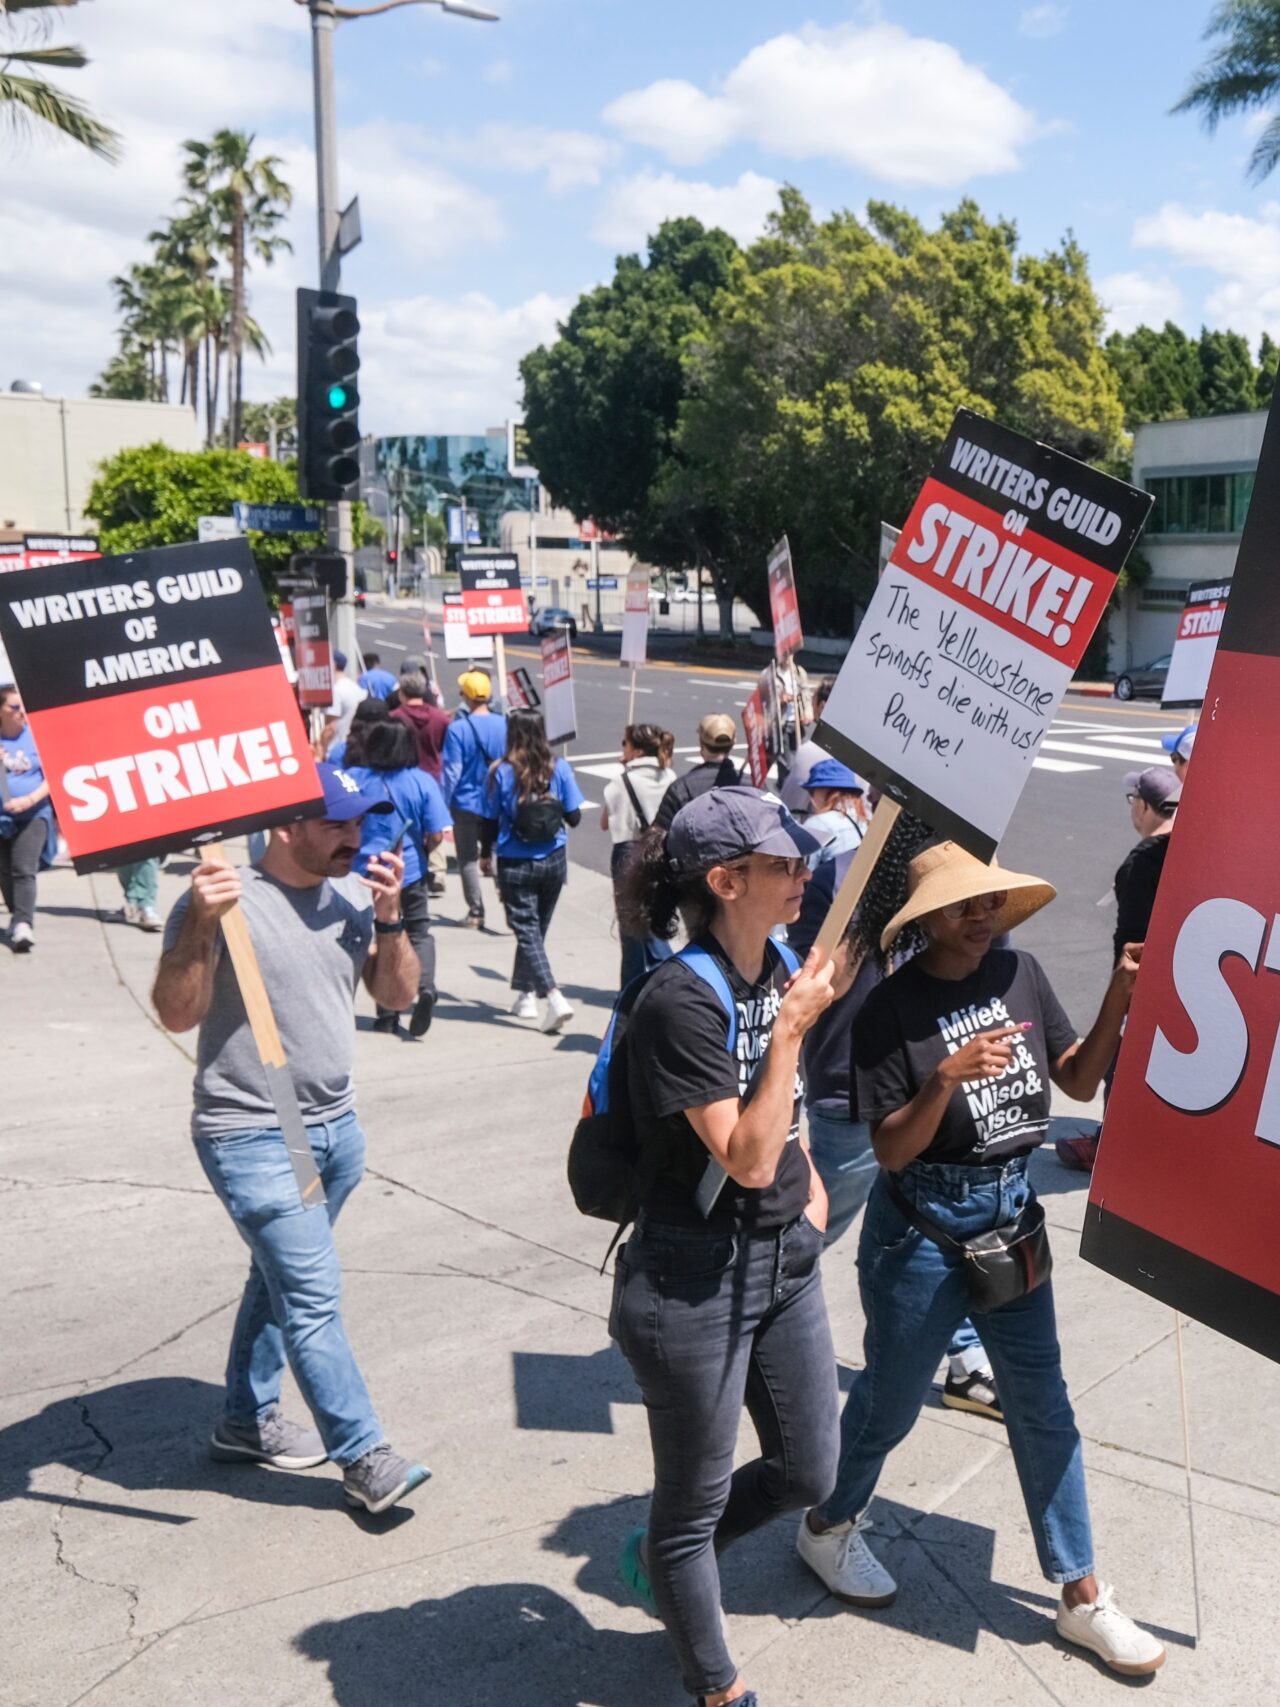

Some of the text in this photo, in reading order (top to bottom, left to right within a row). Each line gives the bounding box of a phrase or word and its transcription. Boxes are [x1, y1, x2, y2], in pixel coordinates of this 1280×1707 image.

[950, 437, 1122, 546] WRITERS GUILD
[1002, 509, 1029, 536] ON
[9, 568, 242, 628] WRITERS GUILD
[907, 502, 1094, 647] STRIKE!
[125, 616, 157, 642] OF
[887, 585, 1054, 717] The Yellowstone
[84, 638, 220, 688] AMERICA
[866, 632, 932, 689] spinoffs
[937, 676, 972, 713] die
[971, 702, 1009, 738] with
[143, 700, 200, 739] ON
[883, 692, 917, 753] Pay
[62, 721, 299, 822] STRIKE!
[937, 997, 1010, 1041] Mife&
[967, 1070, 1043, 1120] Miso&
